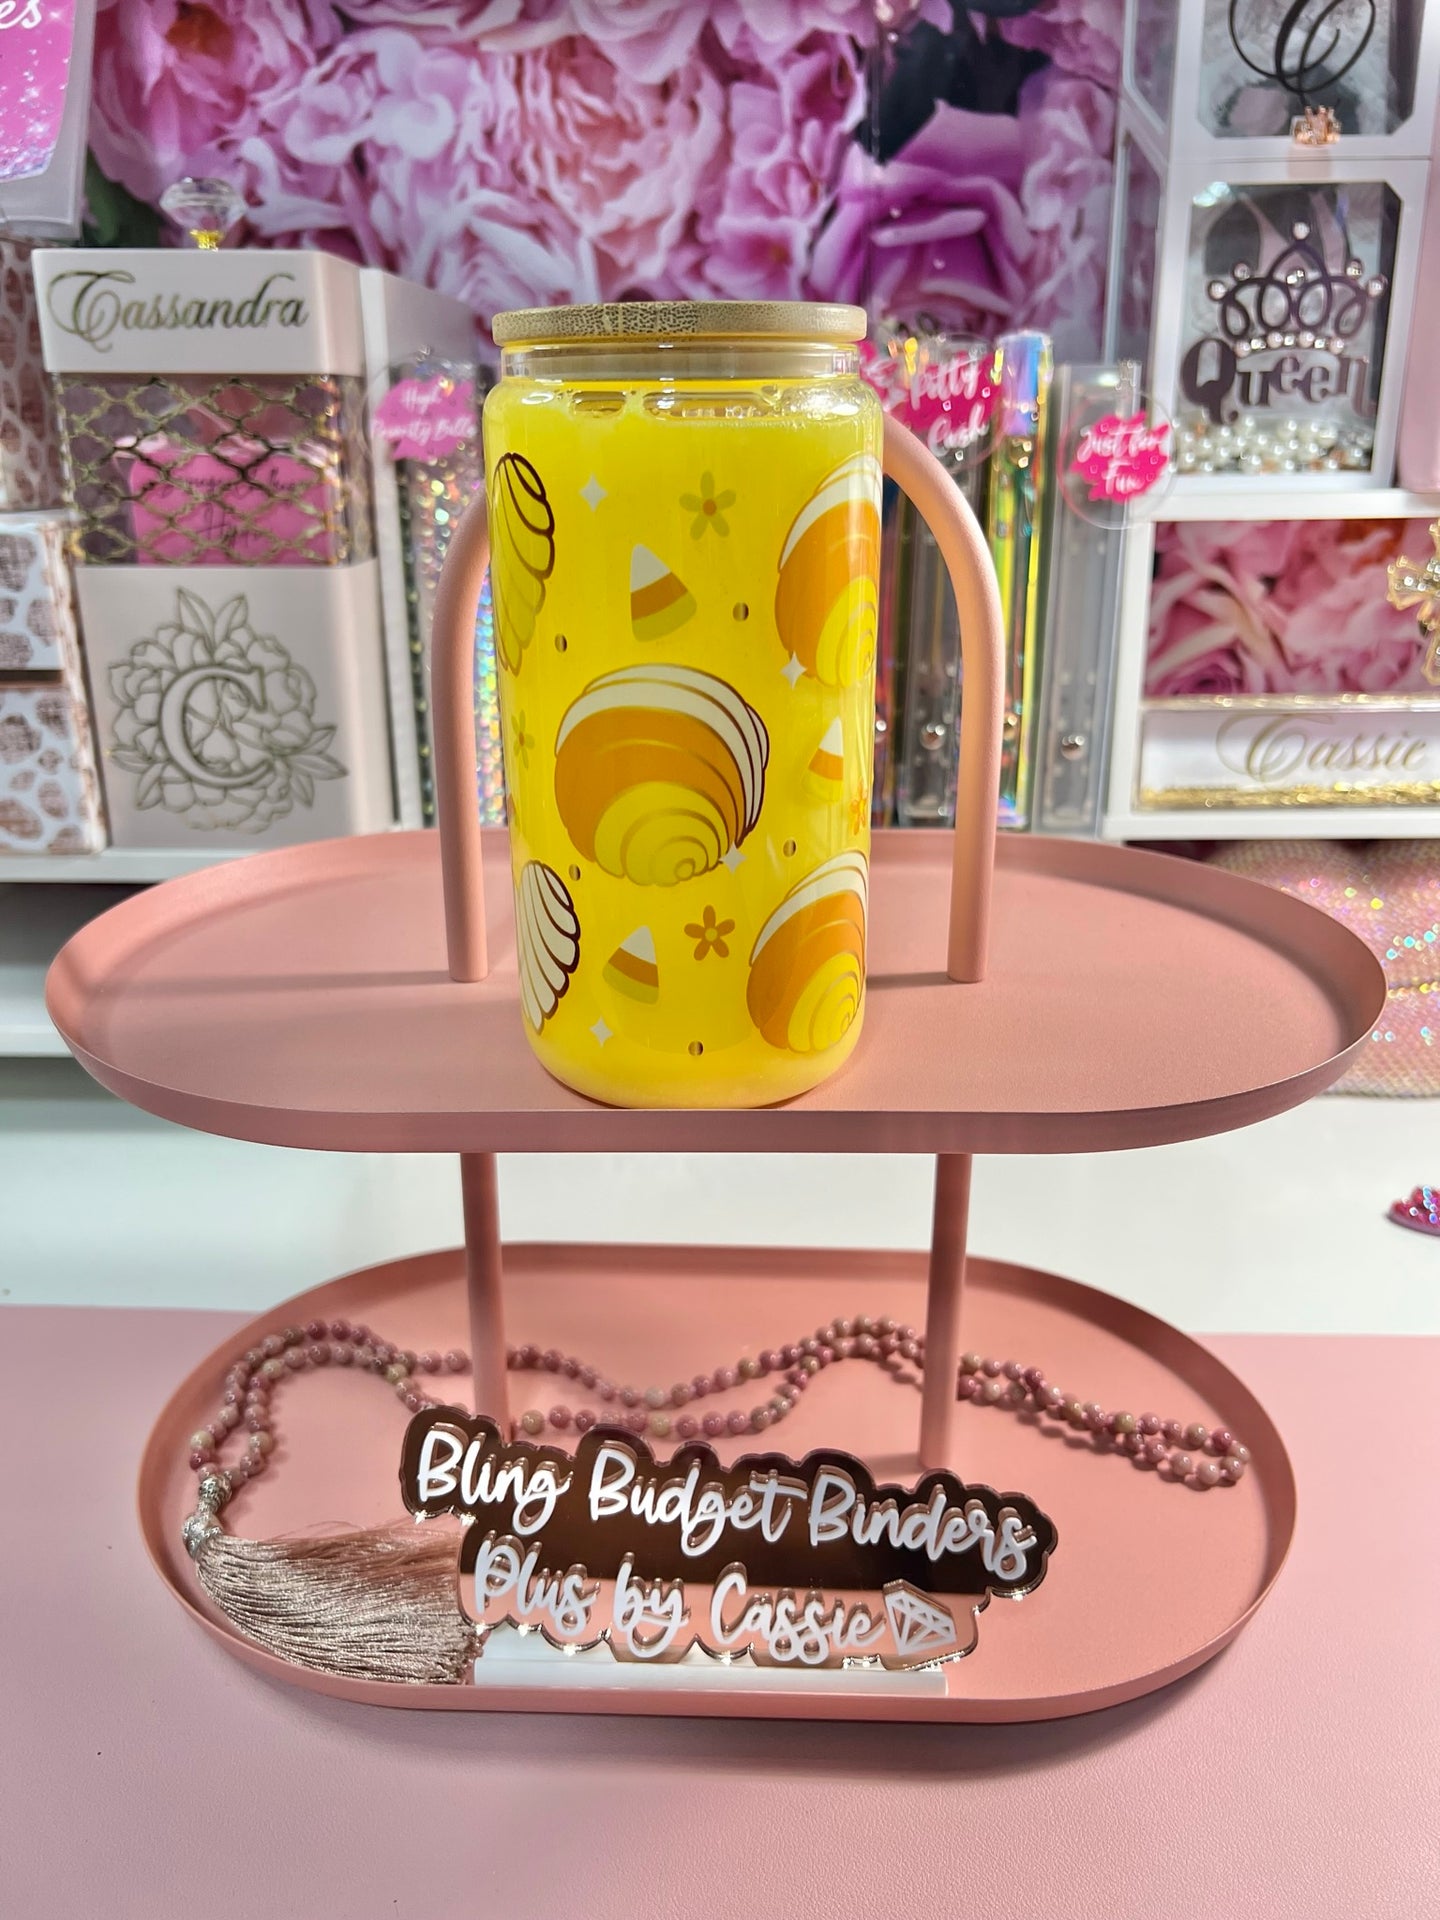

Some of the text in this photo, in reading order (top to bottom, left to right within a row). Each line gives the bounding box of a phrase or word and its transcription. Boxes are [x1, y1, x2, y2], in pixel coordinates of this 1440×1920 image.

[47, 270, 309, 352] Cassandra
[1216, 713, 1427, 783] Cassie
[416, 1424, 1037, 1580] Bling Budget Binders
[474, 1530, 887, 1664] Plus by Cassie
